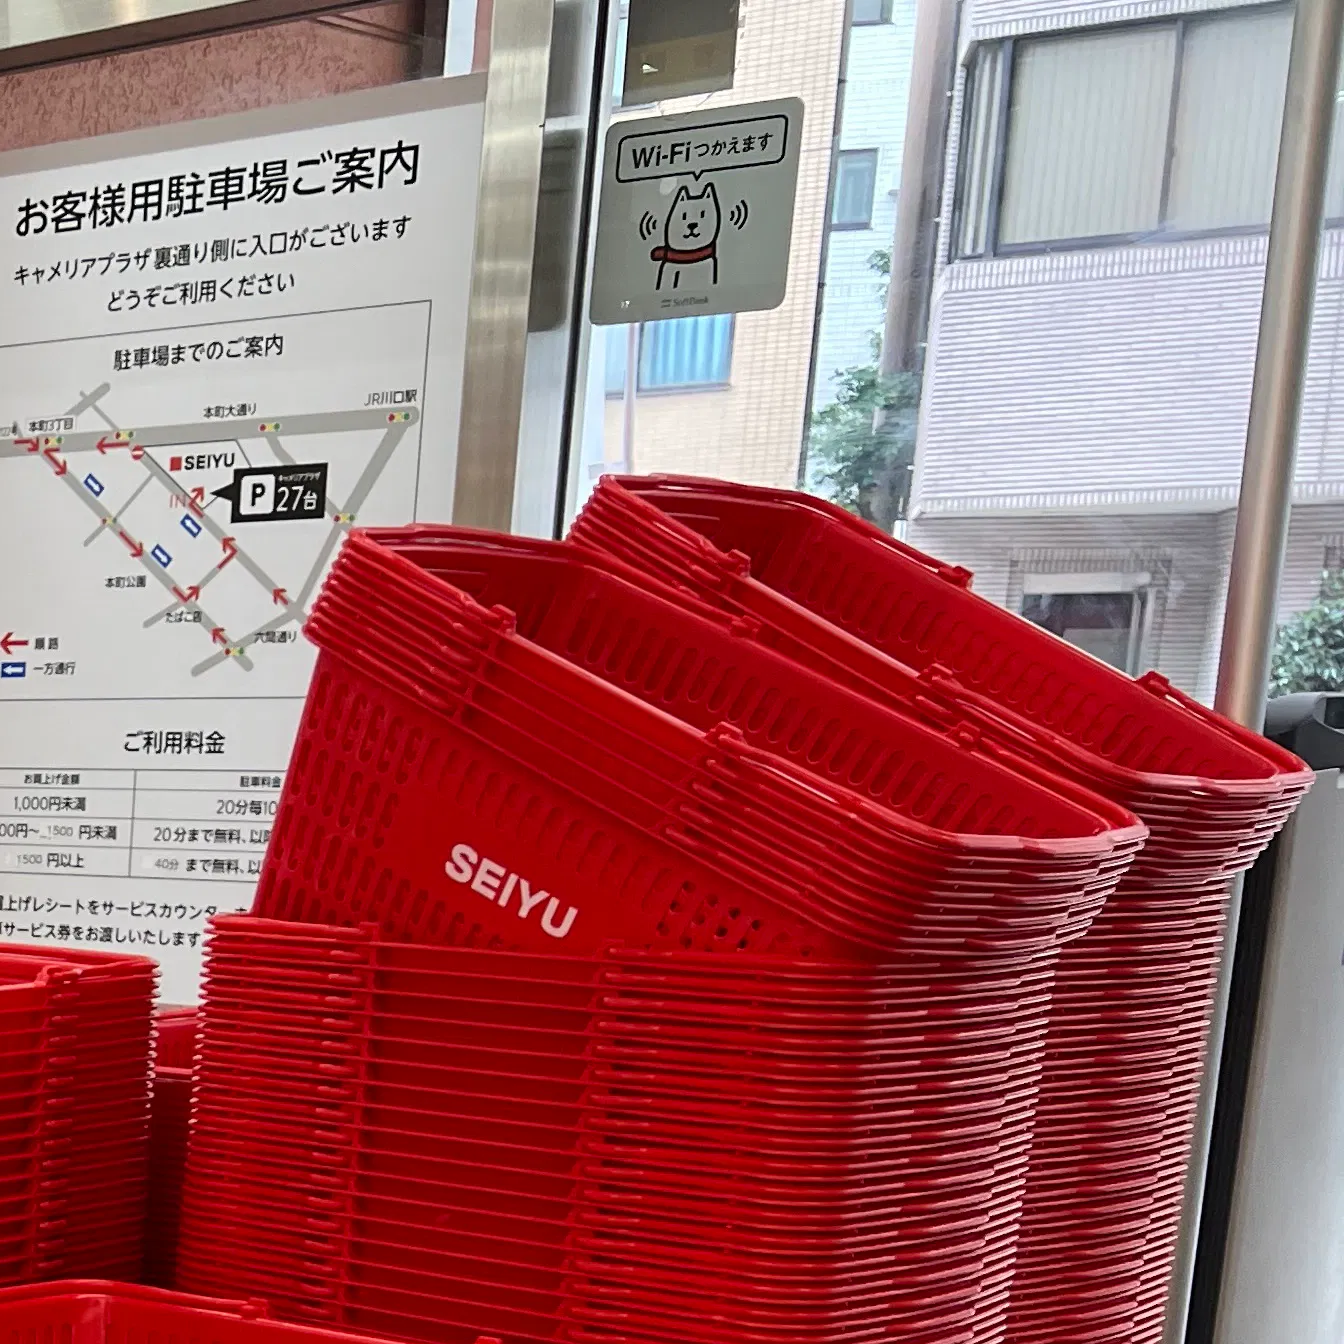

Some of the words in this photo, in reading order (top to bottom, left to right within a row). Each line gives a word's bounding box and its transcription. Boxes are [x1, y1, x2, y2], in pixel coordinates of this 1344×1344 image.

[15, 139, 421, 238] お客様用駐車場ご案内
[13, 214, 413, 287] キャメリアプラザ裏通り側に入口がございます
[106, 272, 296, 313] どうぞご利用ください
[113, 333, 284, 372] 駐車場までのご案内
[364, 388, 418, 407] JR川口駅
[184, 453, 235, 471] SEIYU
[170, 494, 186, 508] IN
[250, 483, 267, 507] P
[276, 486, 318, 512] 27台
[124, 730, 225, 755] ご利用料金
[445, 844, 578, 938] SEIYU
